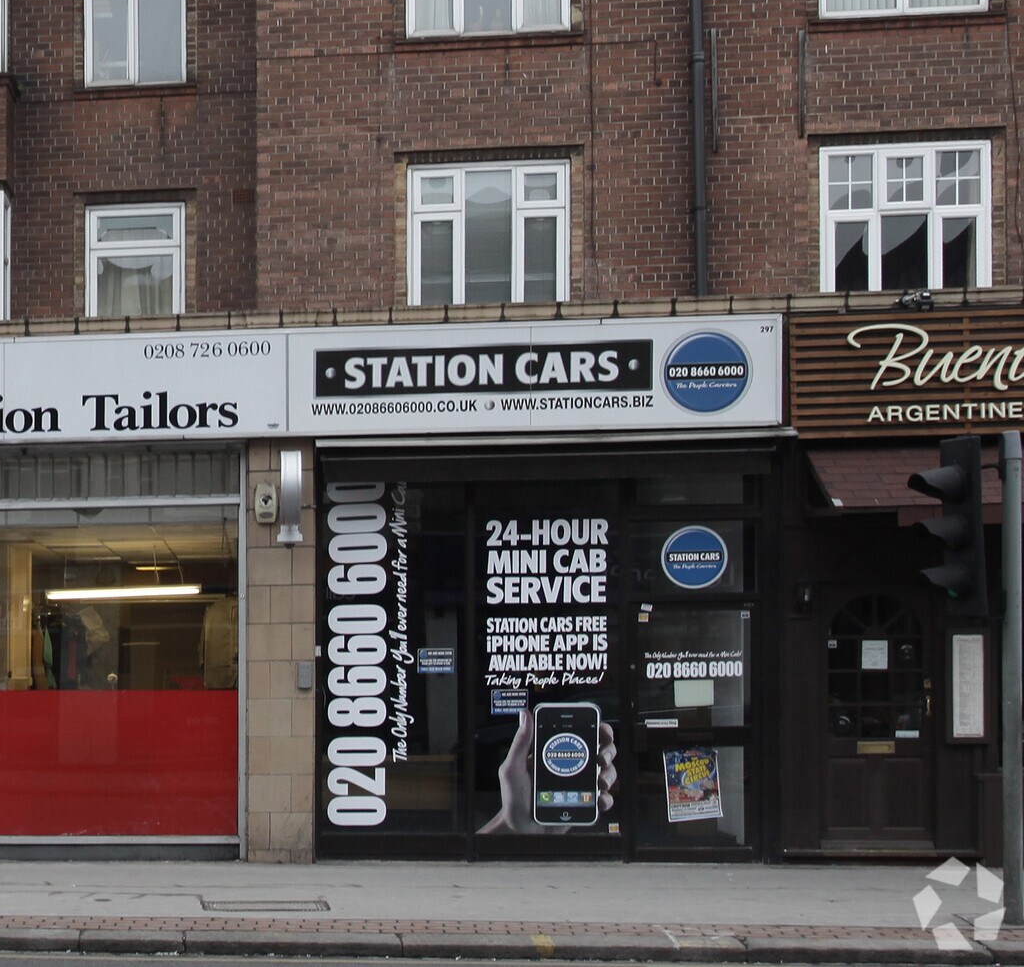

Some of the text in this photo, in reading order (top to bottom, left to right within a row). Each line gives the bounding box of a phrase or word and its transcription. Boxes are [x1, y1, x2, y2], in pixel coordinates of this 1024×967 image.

[143, 340, 271, 359] 0208 726 0600
[344, 350, 620, 390] STATION CARS
[669, 365, 744, 377] 020 8660 6000
[82, 390, 239, 431] Tailors
[311, 395, 654, 416] WWW.02086606000.CO.UK WWW.STATIONCARS.BIZ
[867, 402, 1023, 422] ARGENTINE
[389, 508, 408, 537] Mini
[486, 518, 609, 546] 24-HOUR
[397, 538, 408, 549] a
[391, 549, 408, 570] for
[487, 548, 607, 574] MINI CAB
[669, 552, 720, 562] STATION CARS
[392, 572, 408, 603] need
[486, 576, 607, 604] SERVICE
[397, 603, 408, 631] ever
[486, 616, 607, 633] STATION CARS FREE
[326, 482, 387, 826] 020 8660 6000
[486, 634, 608, 653] iPHONE APP IS
[489, 653, 608, 671] AVAILABLE NOW!
[646, 661, 744, 679] 020 8660 6000
[390, 665, 408, 711] Number
[484, 671, 604, 689] Taking People Places!
[389, 711, 414, 739] Only
[392, 739, 408, 763] The
